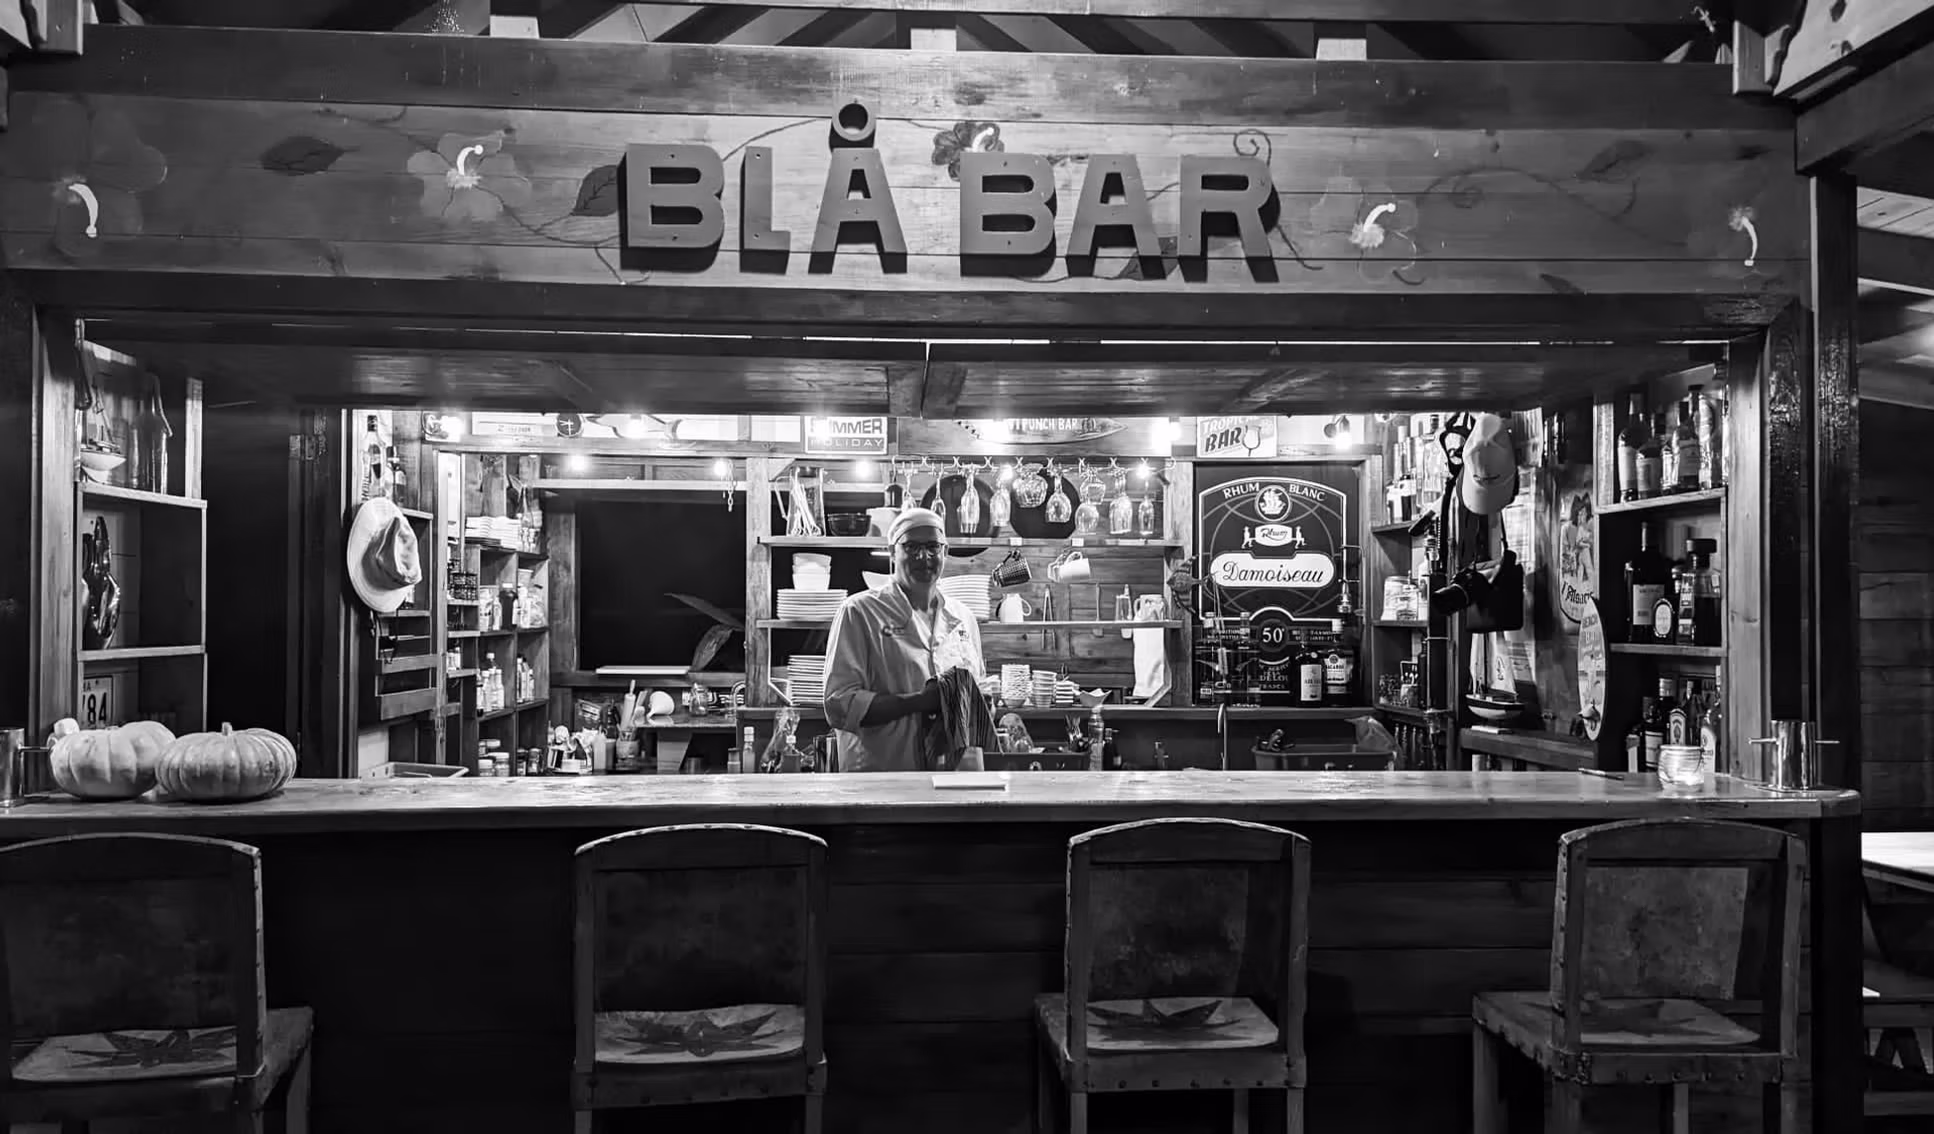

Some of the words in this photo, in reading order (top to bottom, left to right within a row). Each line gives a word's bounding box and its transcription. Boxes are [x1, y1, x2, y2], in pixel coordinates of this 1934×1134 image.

[621, 101, 907, 265] BLÅ
[960, 153, 1279, 272] BAR
[810, 417, 883, 435] MMER
[1058, 417, 1078, 431] BAR
[1205, 427, 1242, 453] BAR
[1222, 482, 1260, 499] RHUM
[1289, 483, 1326, 502] BLANC
[1222, 560, 1325, 583] Damoiseau
